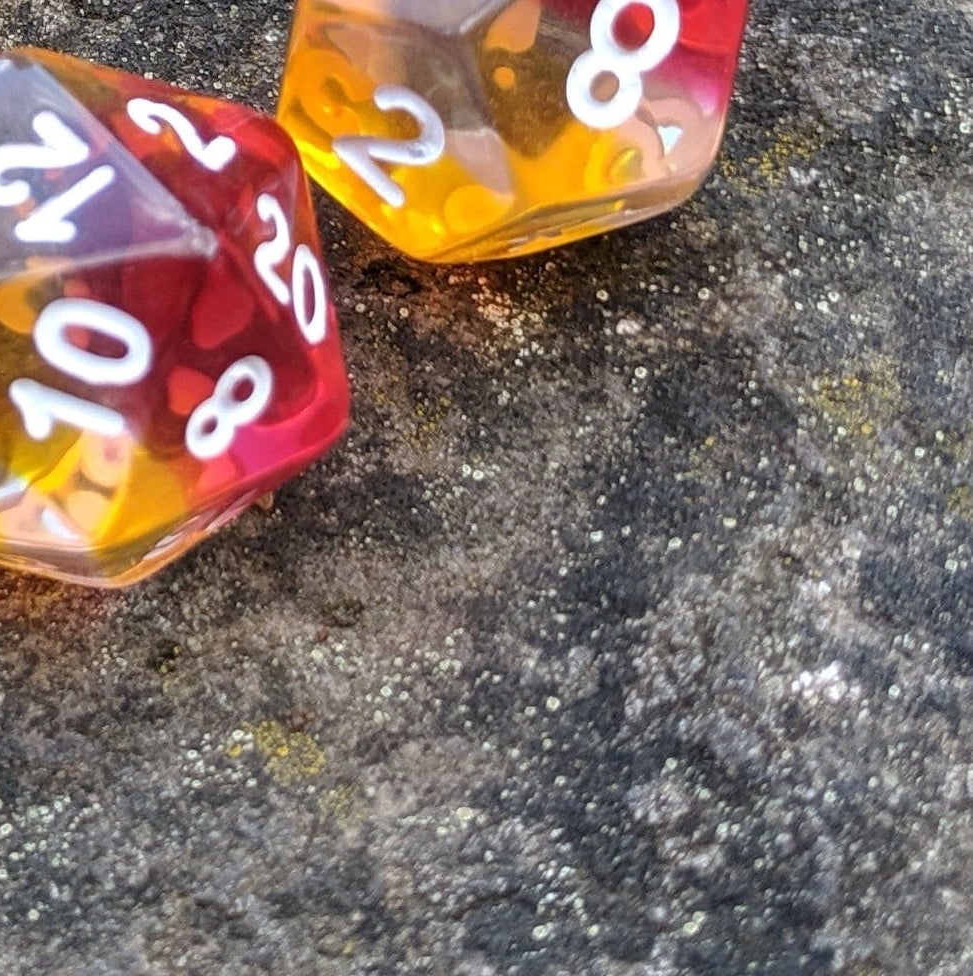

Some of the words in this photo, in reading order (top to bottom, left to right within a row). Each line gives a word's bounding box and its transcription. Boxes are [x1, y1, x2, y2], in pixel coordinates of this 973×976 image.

[127, 97, 237, 171] 2
[332, 84, 446, 208] 2
[254, 193, 326, 346] 20
[9, 298, 152, 439] 10
[185, 355, 273, 461] 8
